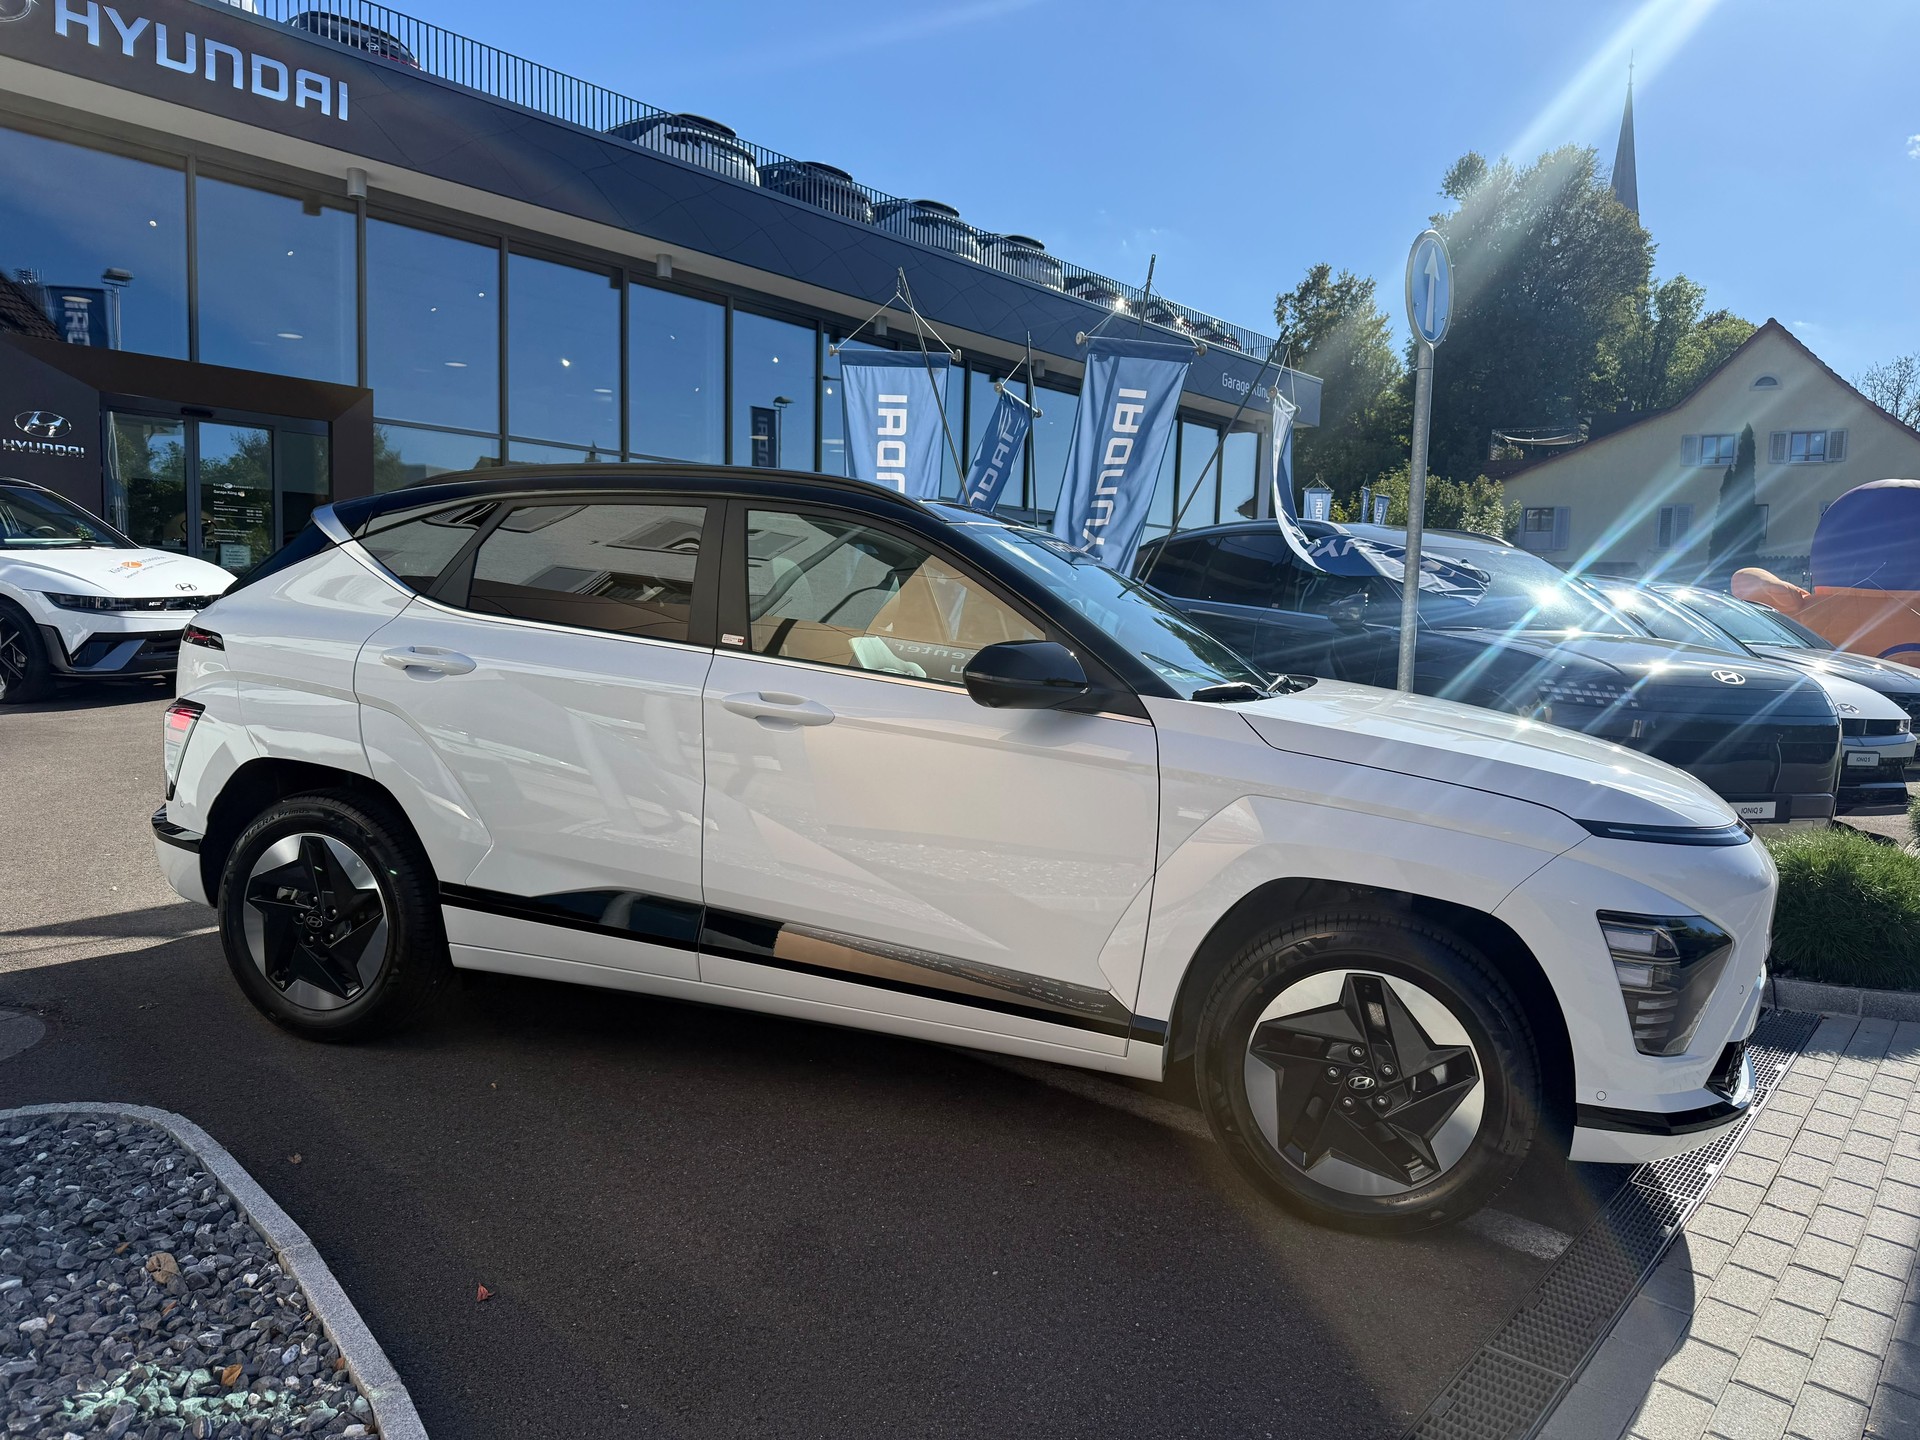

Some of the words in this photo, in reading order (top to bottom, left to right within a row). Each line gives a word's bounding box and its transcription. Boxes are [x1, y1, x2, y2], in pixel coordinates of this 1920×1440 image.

[55, 0, 348, 122] HYUNDAI
[1222, 372, 1250, 396] Garage
[2, 438, 85, 459] HYUNDAI
[1081, 388, 1148, 552] YUNDAI
